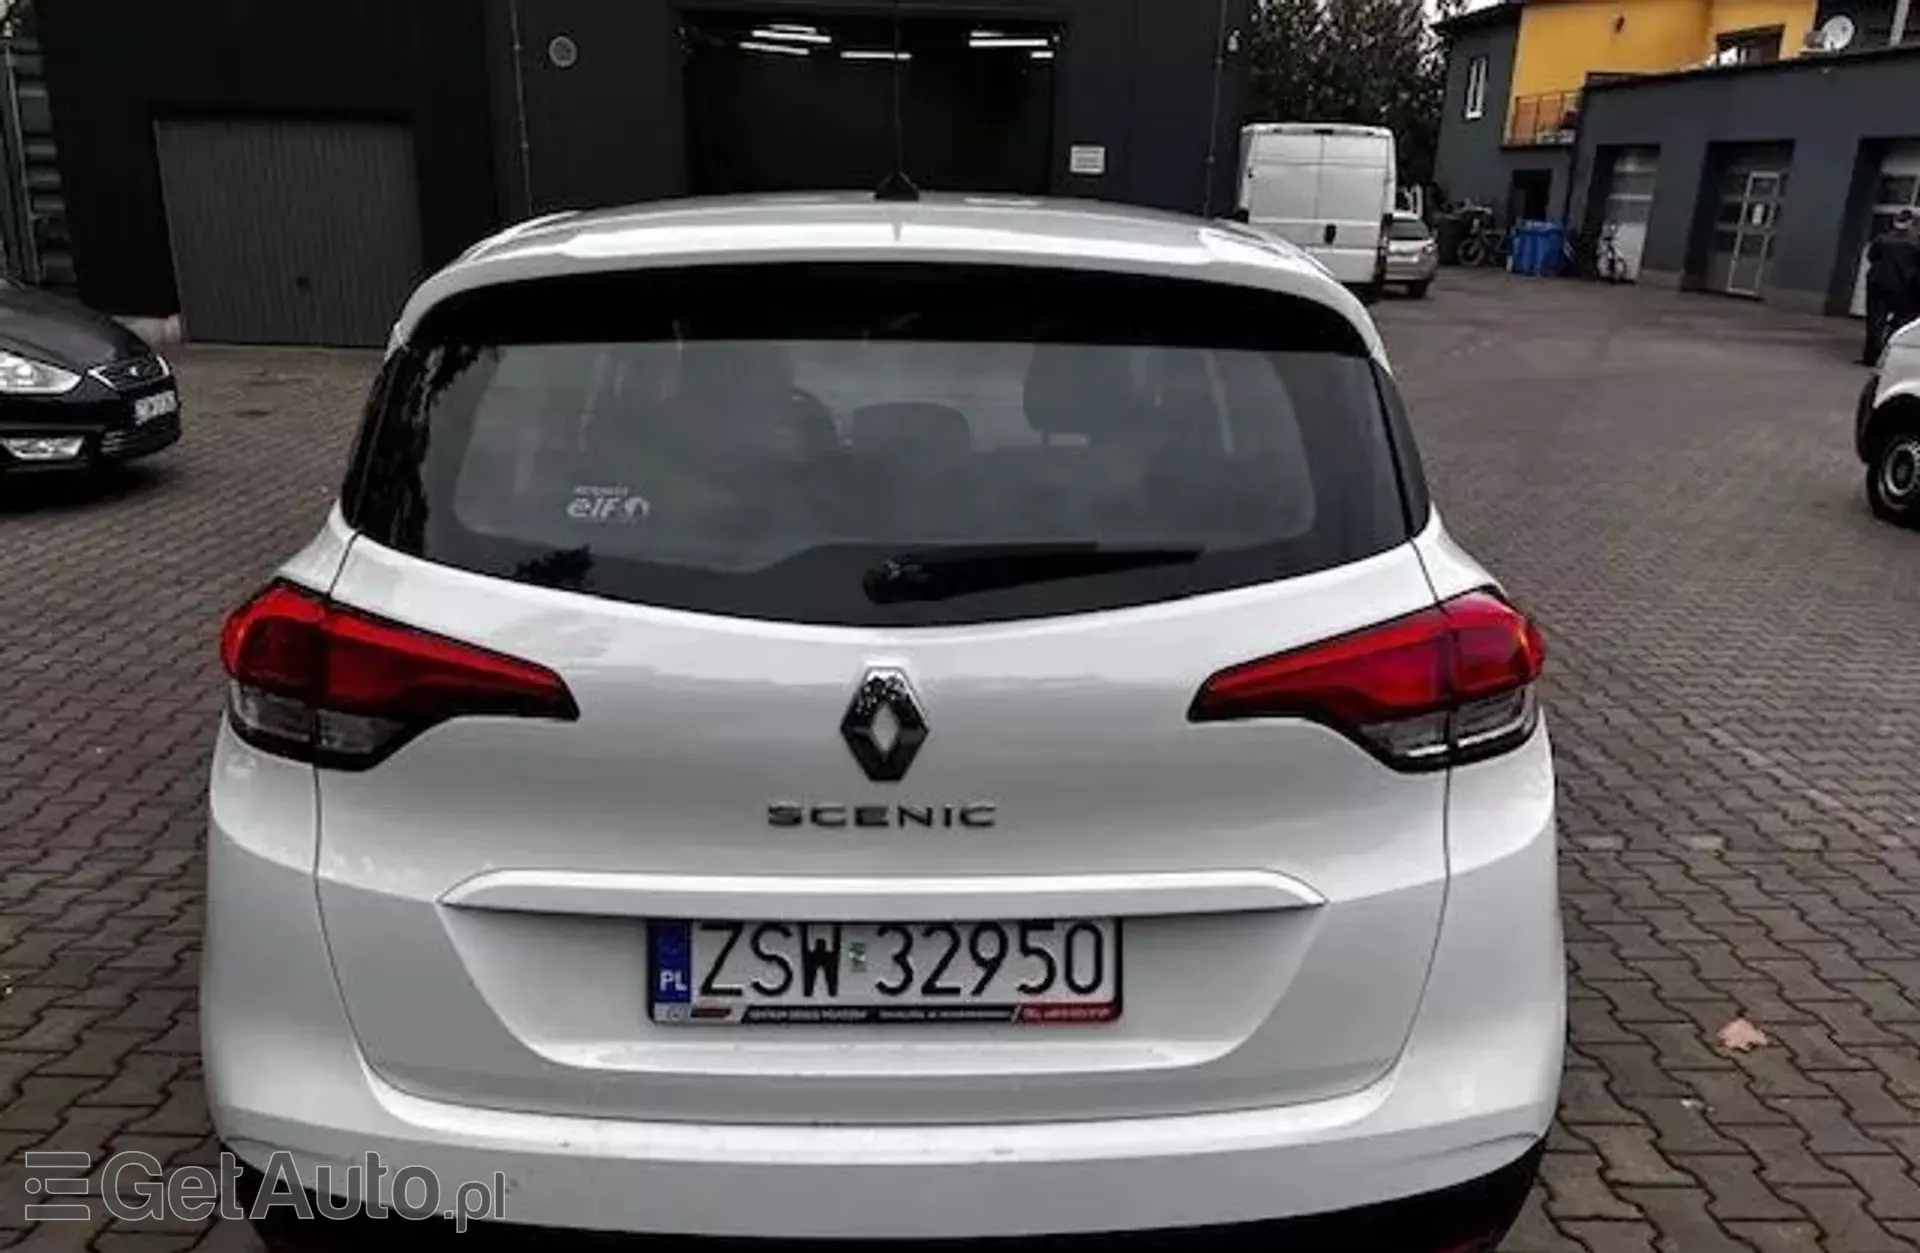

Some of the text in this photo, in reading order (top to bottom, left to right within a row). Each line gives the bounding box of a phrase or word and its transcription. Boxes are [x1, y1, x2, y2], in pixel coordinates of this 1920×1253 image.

[767, 806, 997, 828] SCENIC
[700, 920, 1104, 997] ZSW 32950
[659, 970, 688, 992] PL
